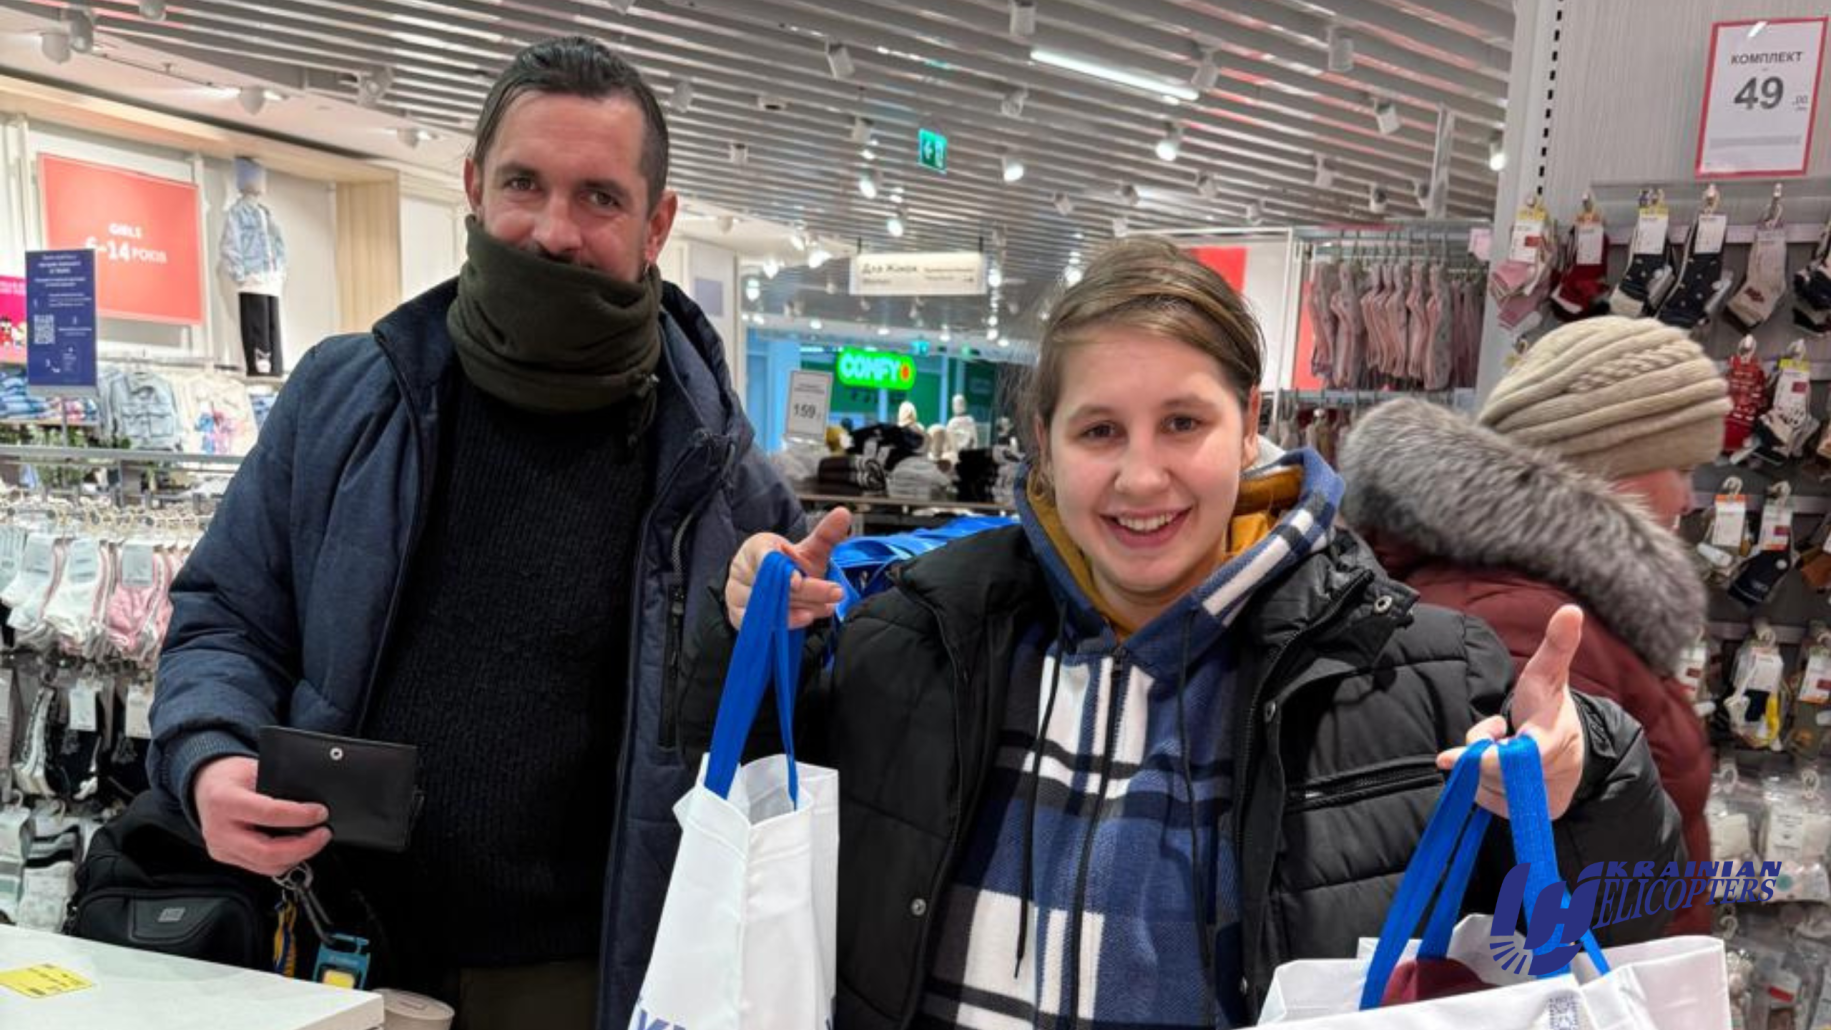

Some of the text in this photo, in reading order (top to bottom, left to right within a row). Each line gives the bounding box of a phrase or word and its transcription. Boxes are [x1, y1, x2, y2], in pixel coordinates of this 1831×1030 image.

[1731, 51, 1802, 64] КОМПЛЕКТ
[1733, 76, 1784, 110] 49
[840, 353, 900, 382] COMFY
